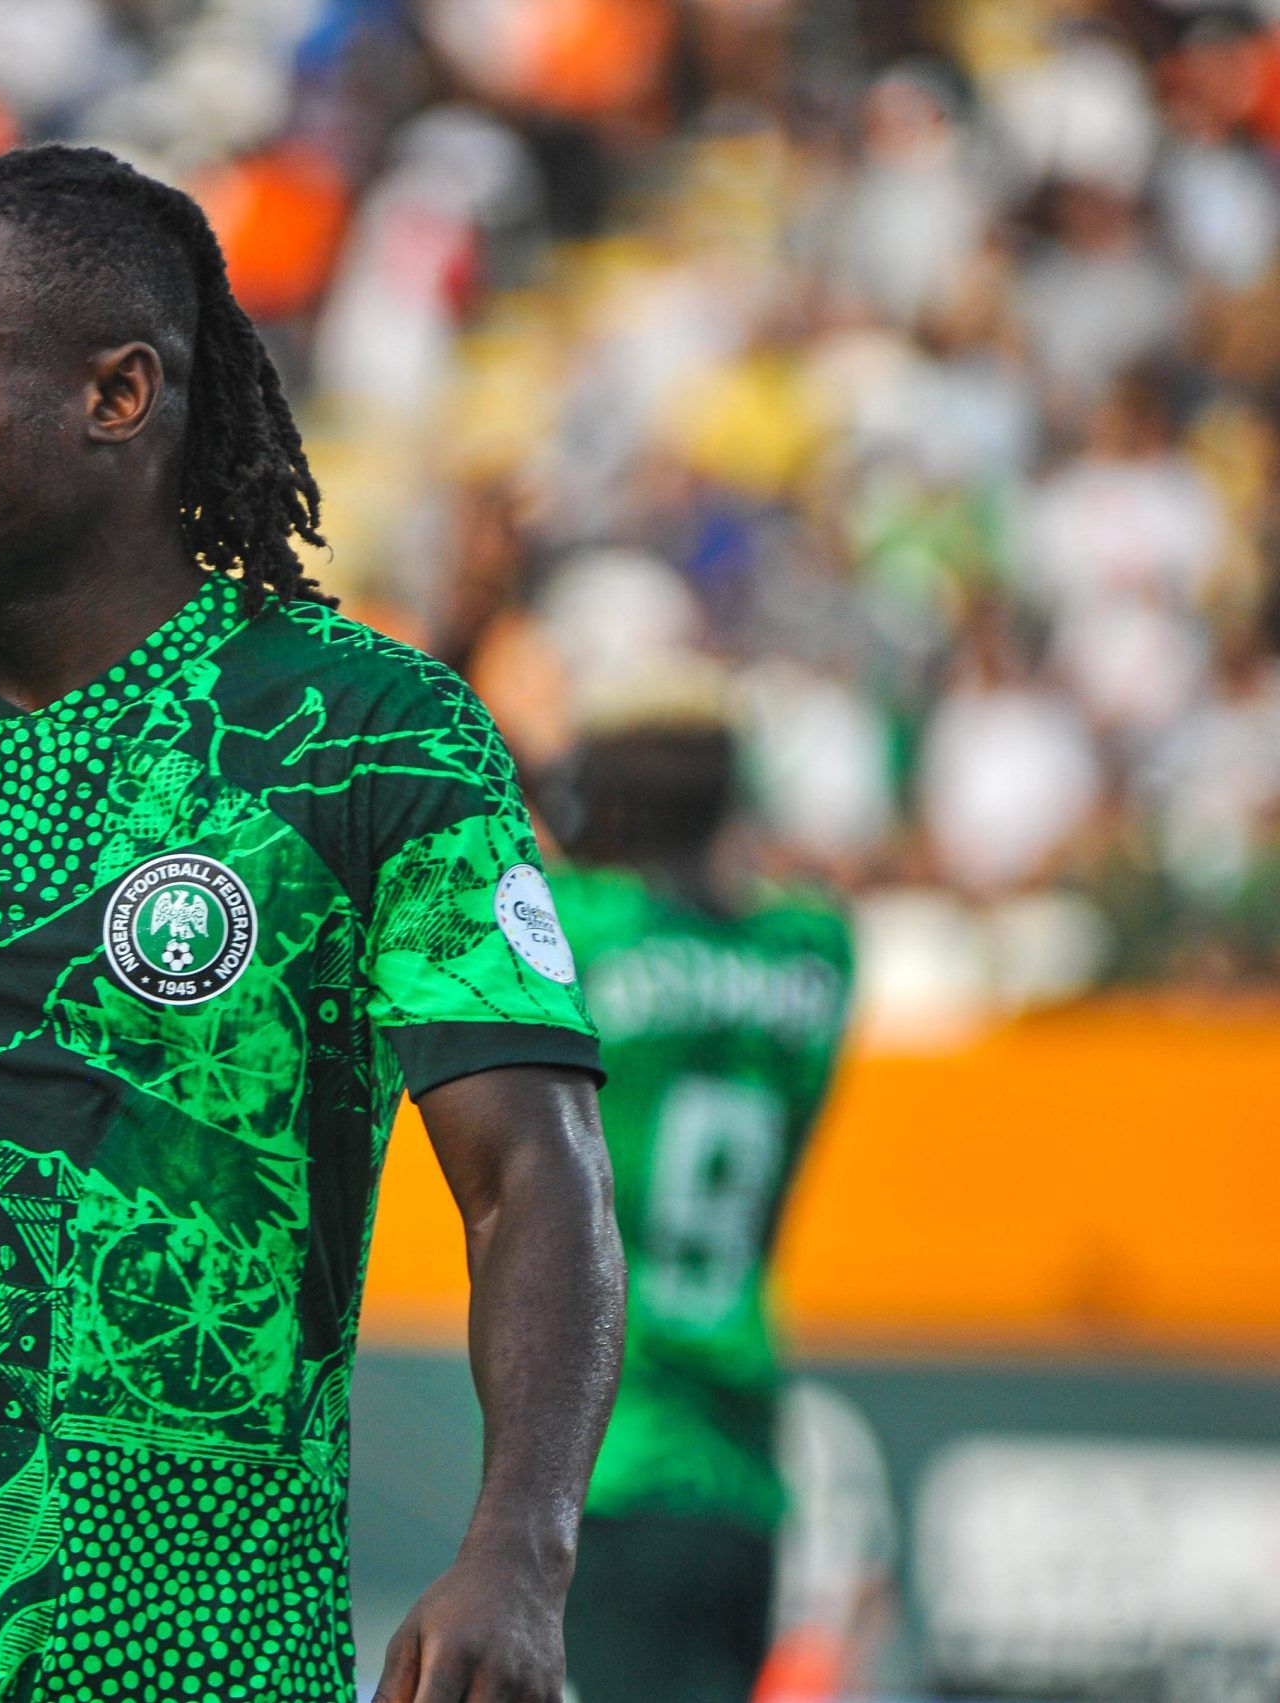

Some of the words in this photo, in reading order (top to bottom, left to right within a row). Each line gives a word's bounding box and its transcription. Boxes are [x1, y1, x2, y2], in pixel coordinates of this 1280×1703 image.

[125, 863, 211, 901] FOOTBALL
[113, 903, 140, 973] NIGERIA
[211, 874, 249, 980] FEDERATION
[157, 979, 197, 996] 1945
[652, 1072, 786, 1325] 9
